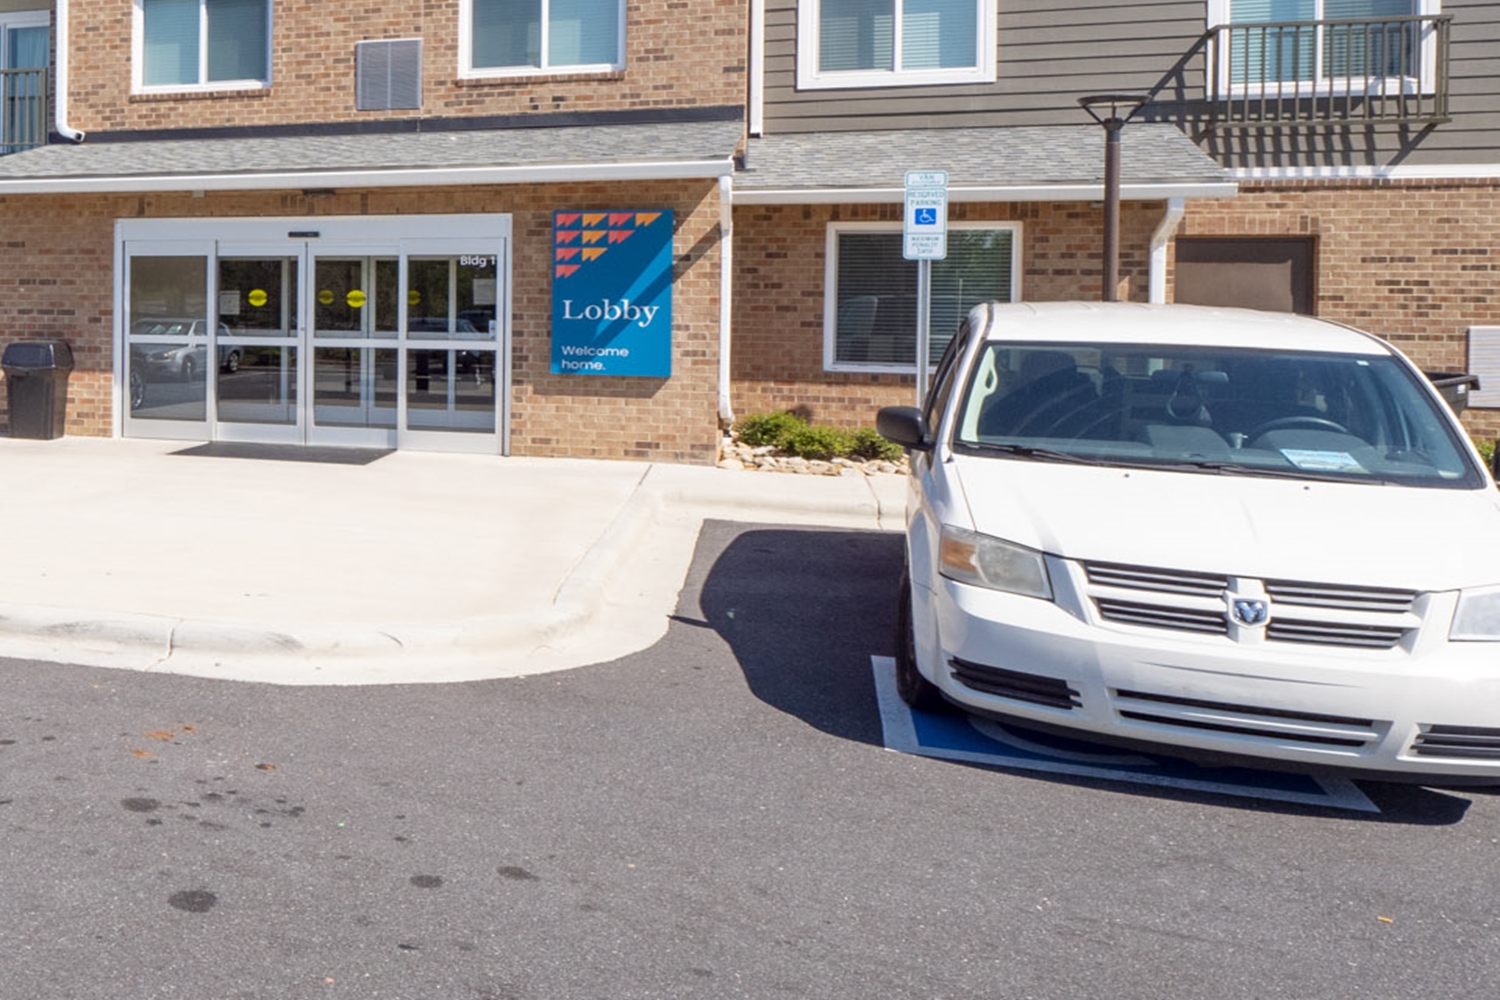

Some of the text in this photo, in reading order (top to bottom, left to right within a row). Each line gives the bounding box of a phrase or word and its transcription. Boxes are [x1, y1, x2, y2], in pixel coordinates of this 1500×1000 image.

[460, 255, 487, 268] Bldg
[562, 298, 660, 328] Lobby
[561, 345, 630, 357] Welcome
[561, 359, 606, 371] home.
